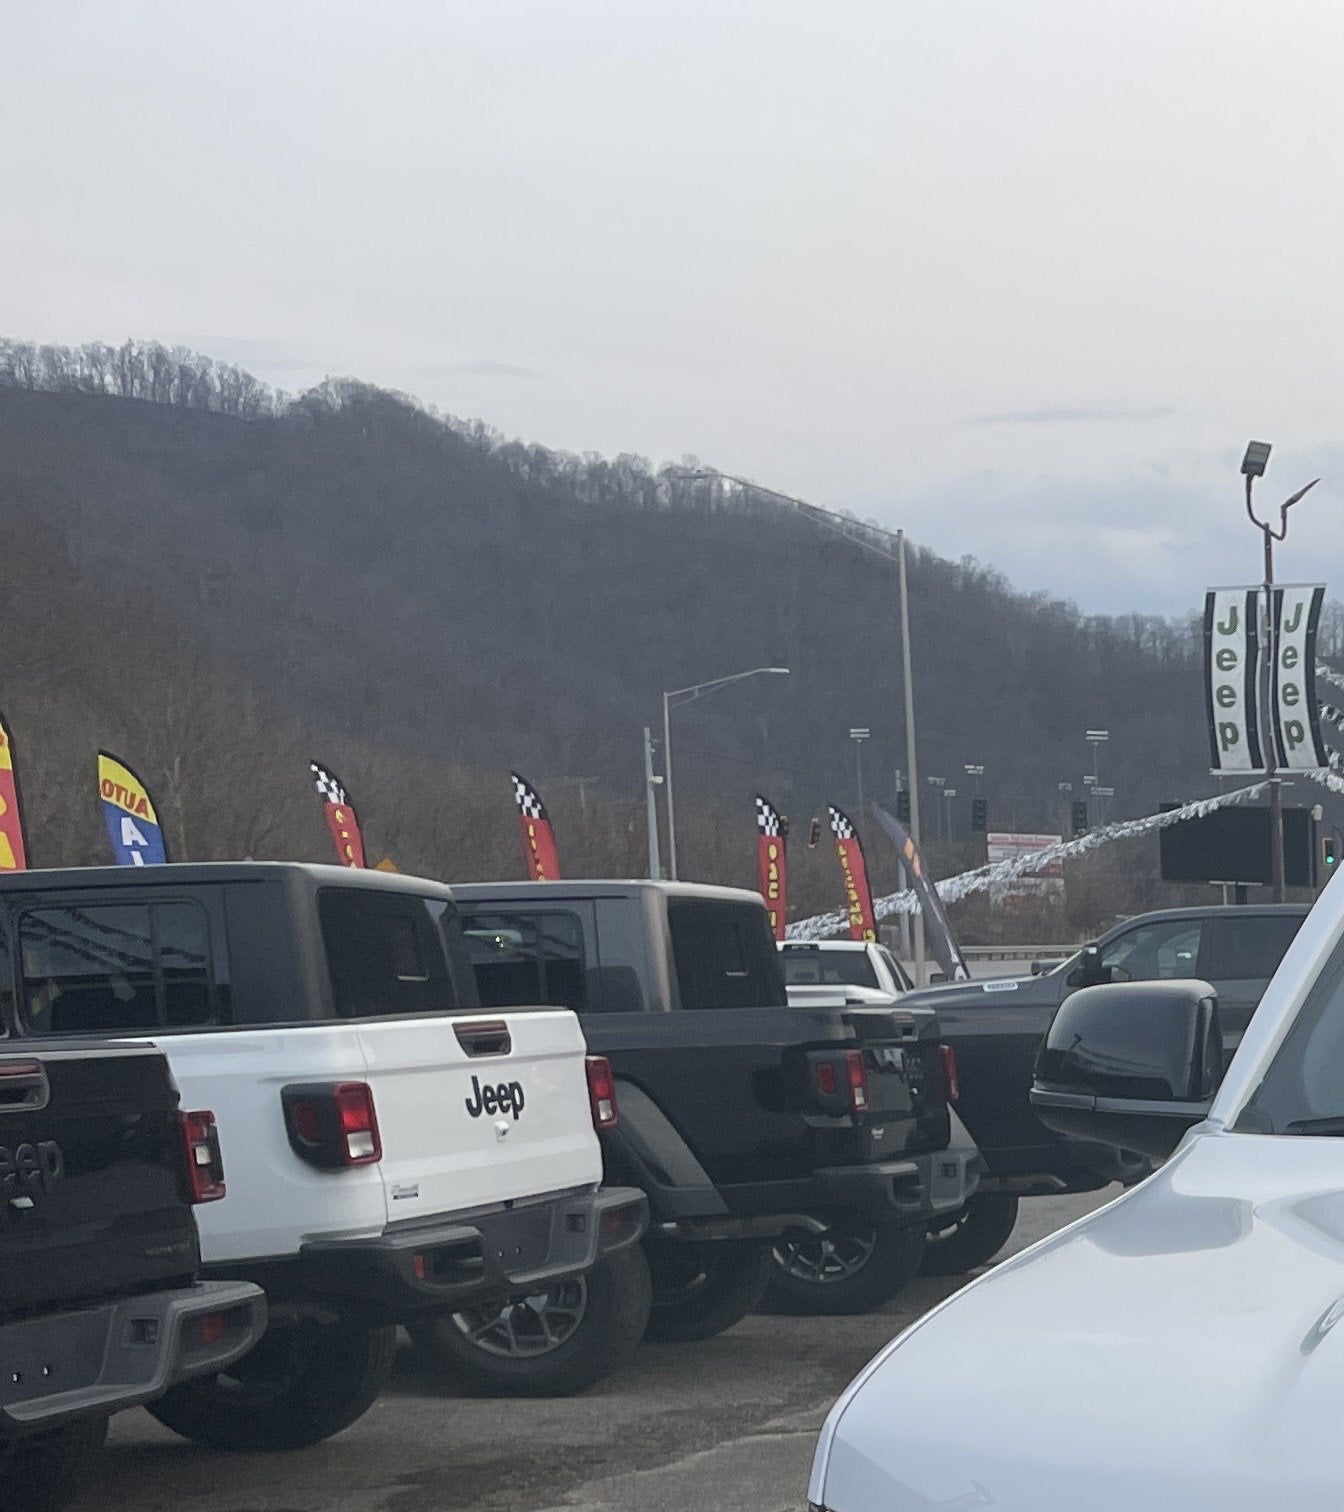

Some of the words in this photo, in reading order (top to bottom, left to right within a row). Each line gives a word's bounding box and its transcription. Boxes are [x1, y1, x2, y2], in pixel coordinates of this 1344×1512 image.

[1216, 605, 1239, 752] Jeep
[1281, 602, 1305, 751] Jeep
[465, 1075, 525, 1121] Jeep
